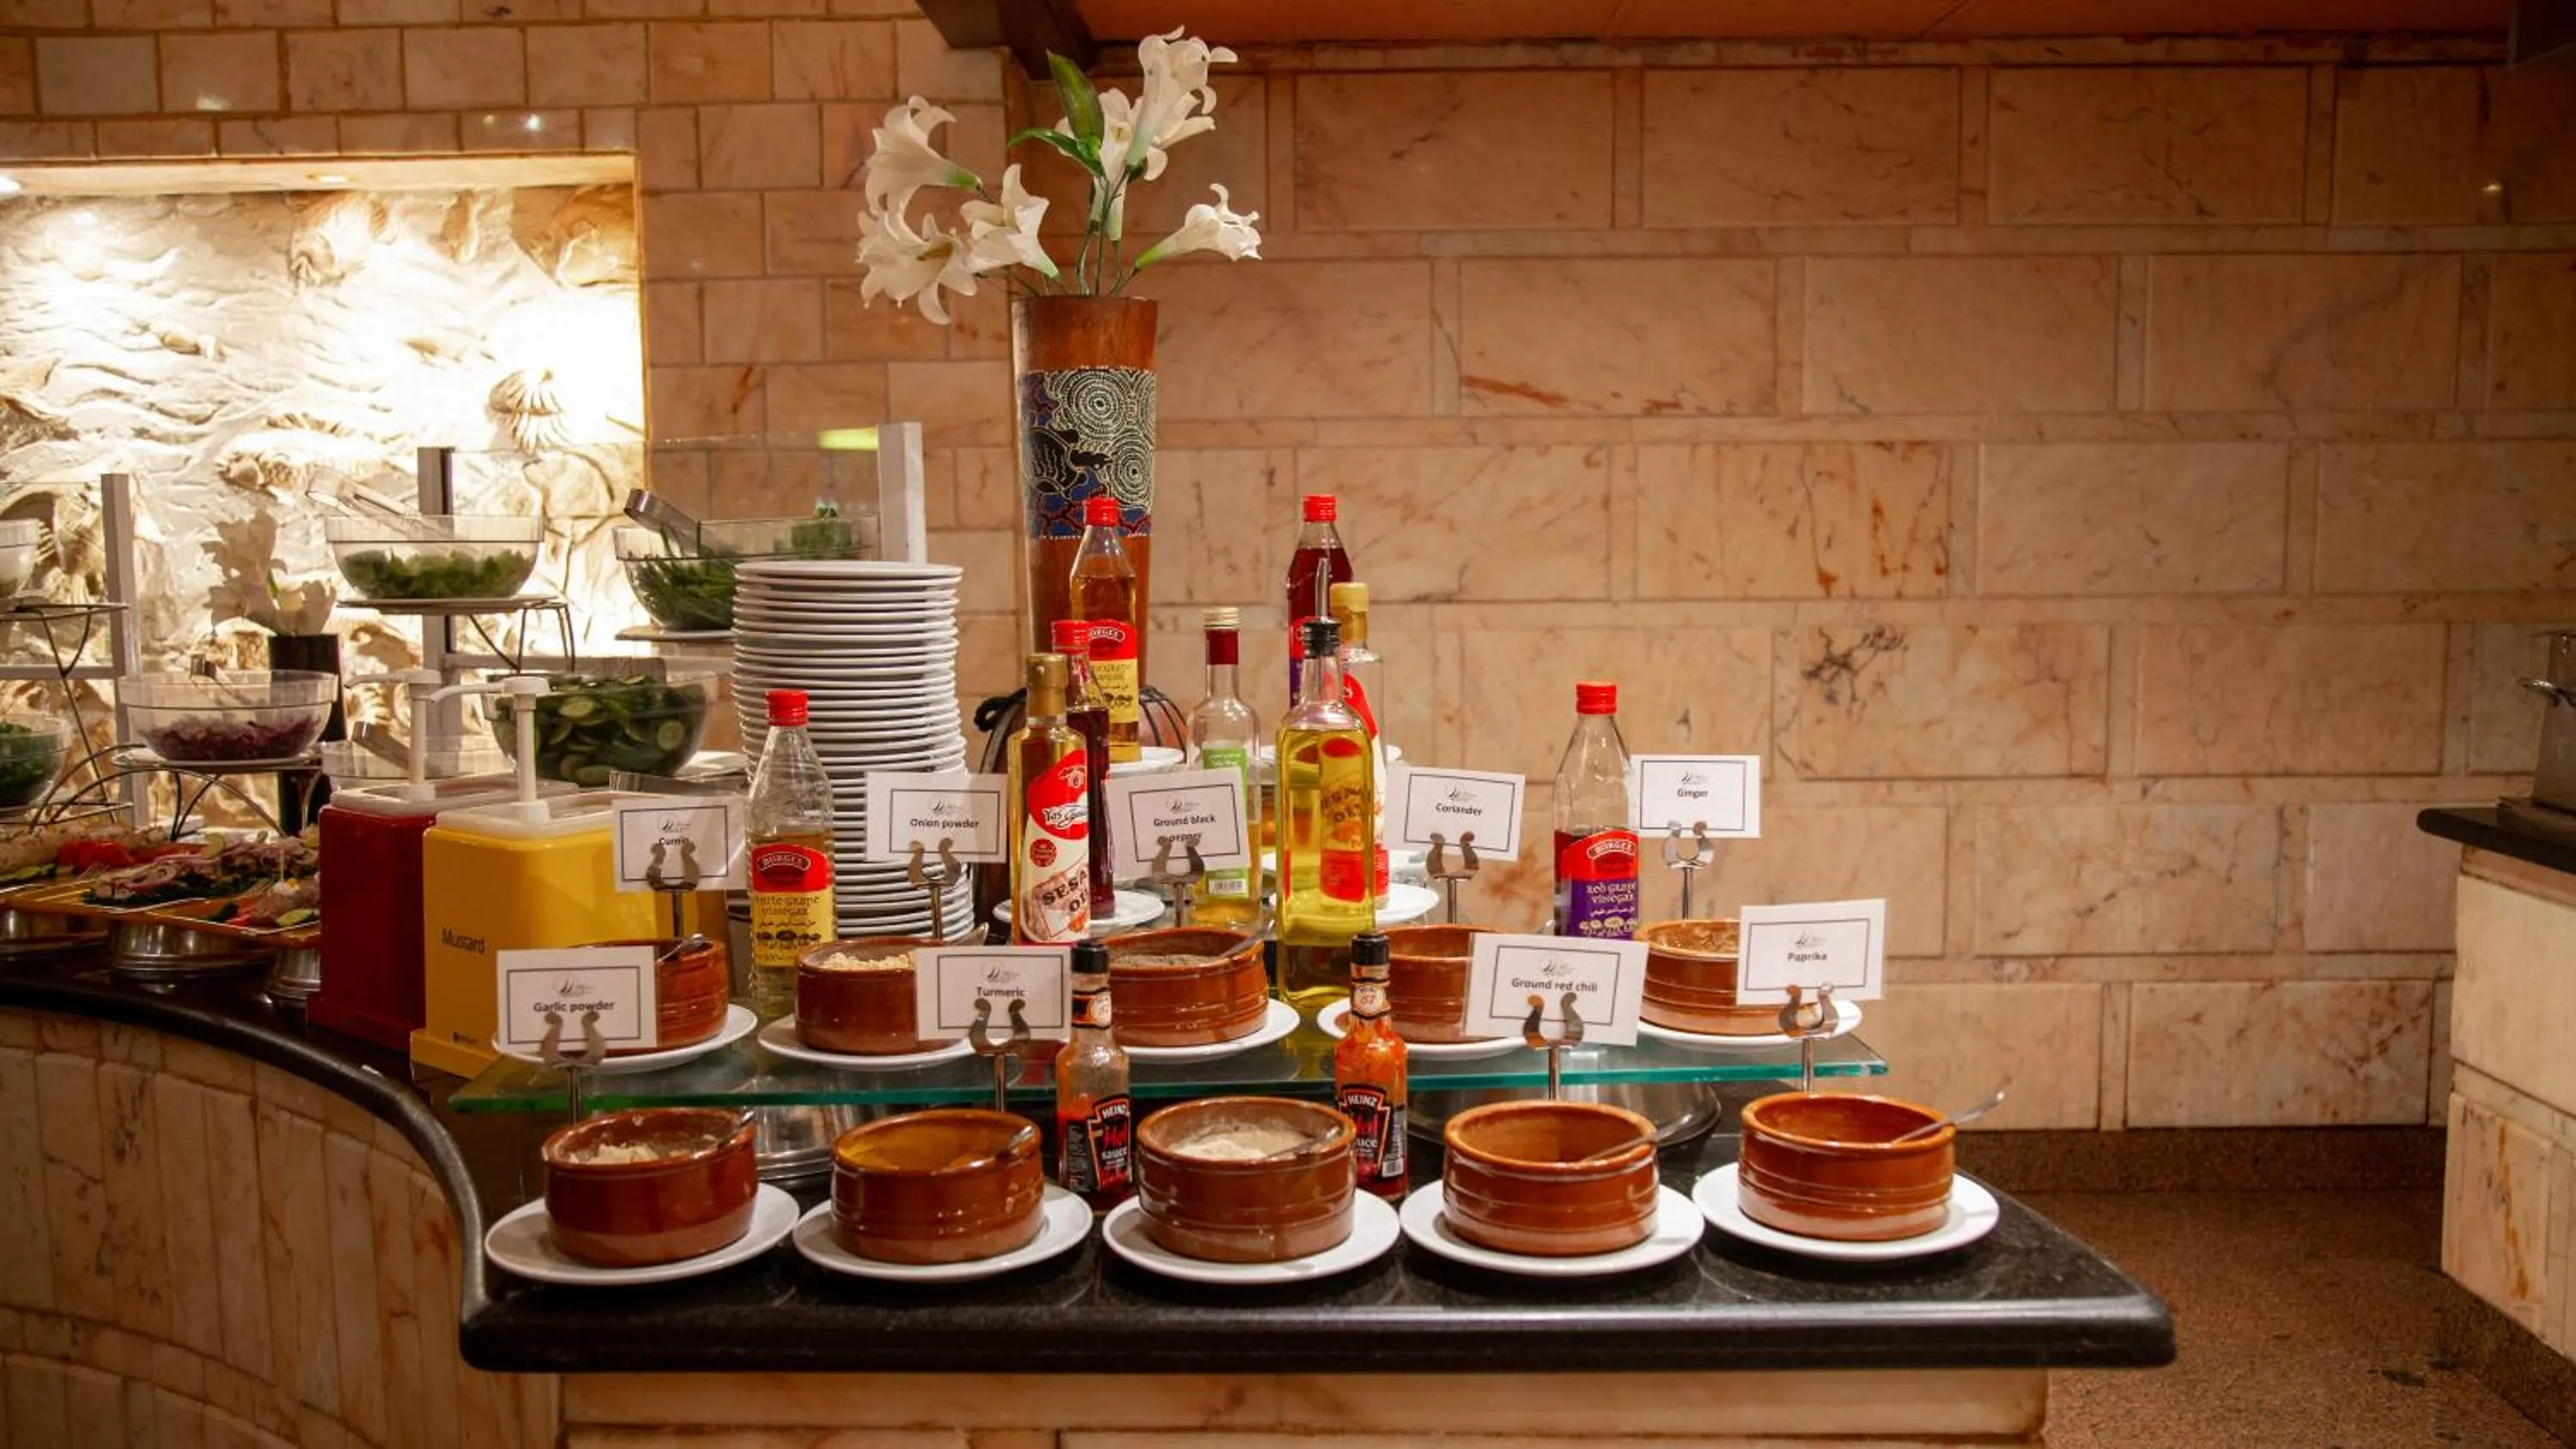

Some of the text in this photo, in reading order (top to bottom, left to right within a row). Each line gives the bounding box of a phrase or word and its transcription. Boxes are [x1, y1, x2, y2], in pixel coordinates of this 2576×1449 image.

[1677, 788, 1709, 799] Ginger
[1436, 803, 1483, 816] Coriander
[910, 818, 979, 829] Onion powder
[1153, 814, 1216, 827] Ground black
[440, 928, 486, 955] Mustard
[1788, 952, 1828, 962] Paprika
[1511, 978, 1552, 990] Ground
[1555, 981, 1574, 991] red
[976, 986, 1026, 997] Turmeric
[533, 1000, 616, 1013] Garlic powder
[1347, 1094, 1379, 1107] HEINZ
[1102, 1103, 1127, 1119] HEINZ
